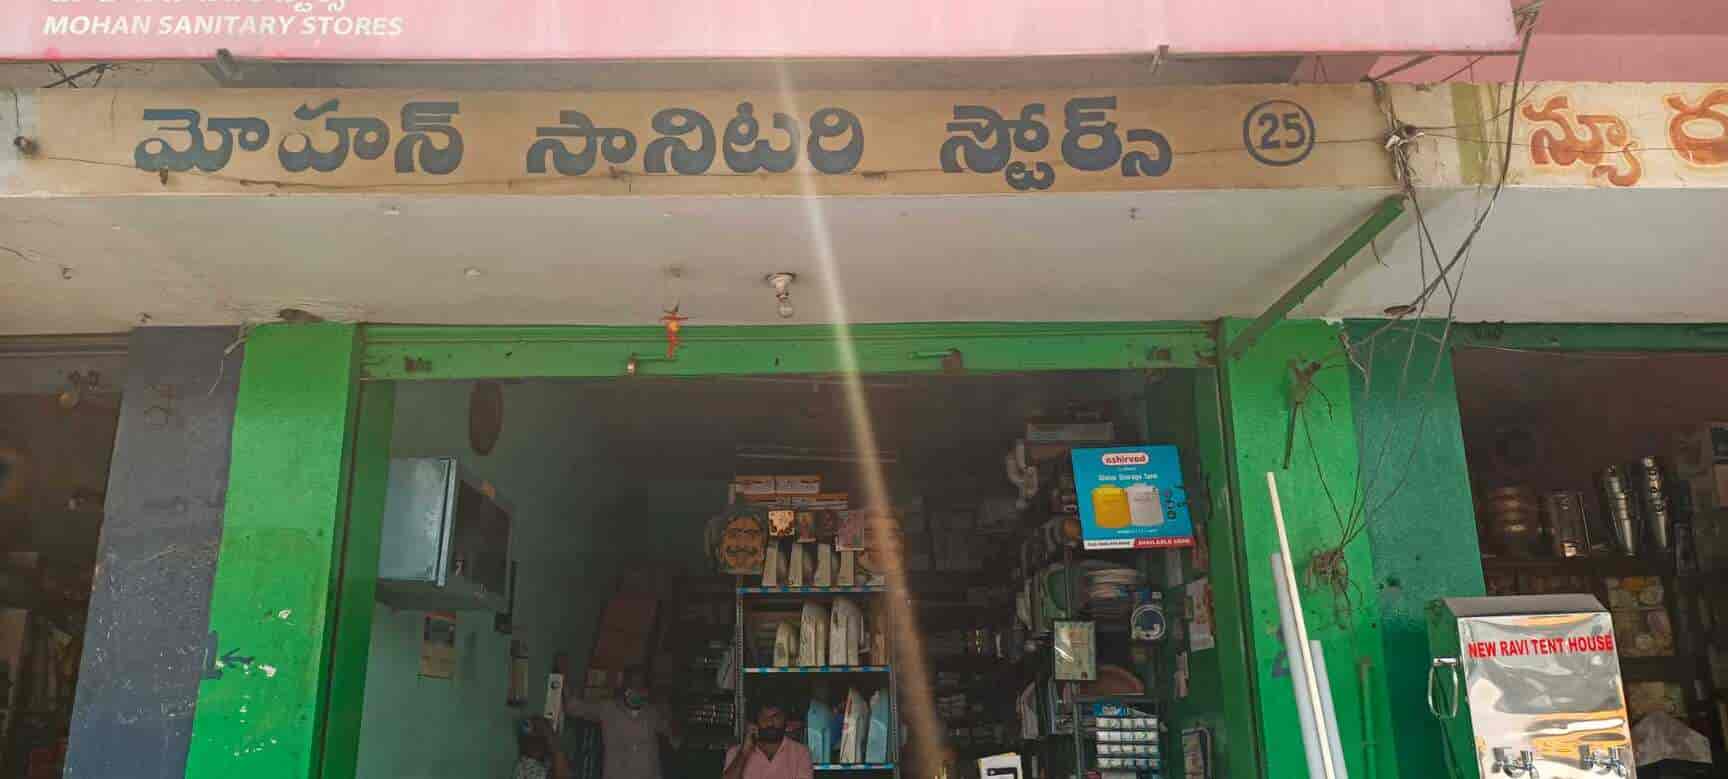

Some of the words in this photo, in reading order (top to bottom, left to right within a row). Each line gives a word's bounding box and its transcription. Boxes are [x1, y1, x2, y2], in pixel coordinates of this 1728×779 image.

[42, 15, 150, 36] MOHAN
[157, 15, 294, 36] SANITARY
[298, 15, 403, 36] STORES
[134, 98, 463, 174] మోహన్
[526, 101, 865, 176] సానిటరి
[940, 95, 1173, 191] స్టోర్స్
[1257, 111, 1307, 150] 25
[1468, 640, 1496, 659] NEW
[1499, 638, 1528, 657] RAVI
[1532, 637, 1565, 655] TENT
[1568, 634, 1614, 653] HOUSE
